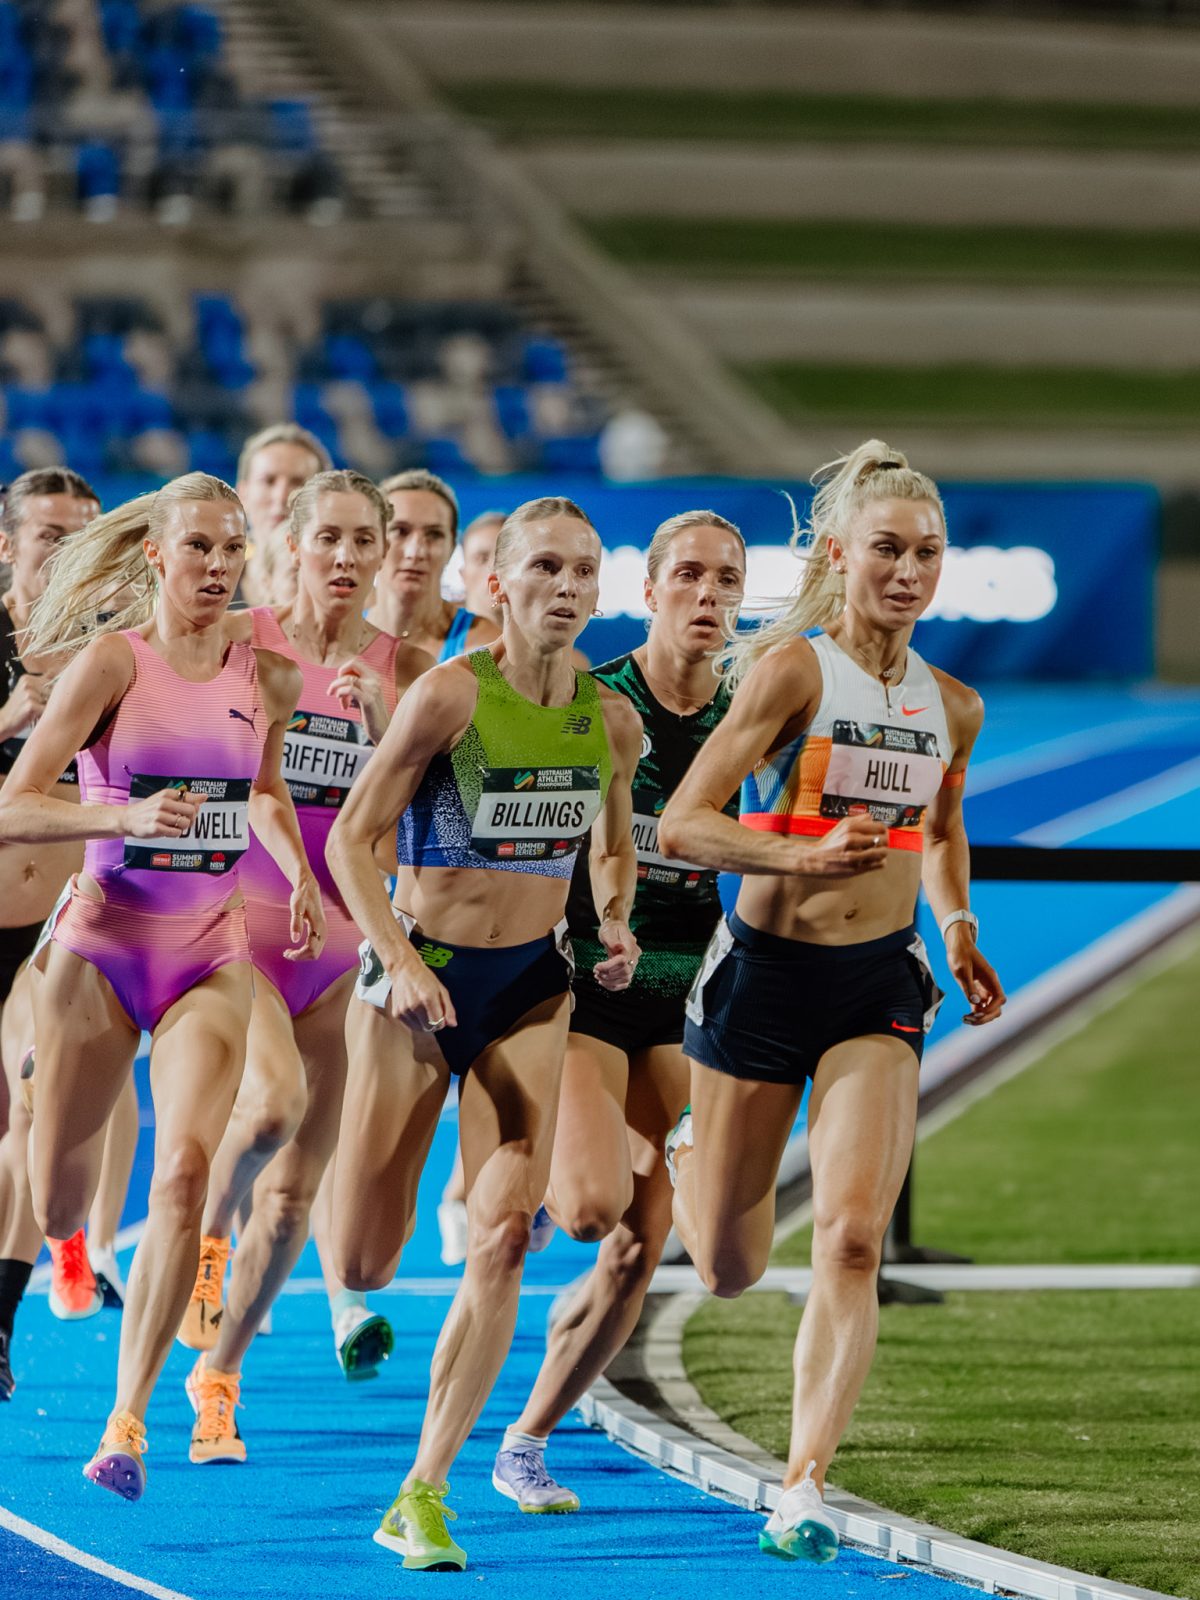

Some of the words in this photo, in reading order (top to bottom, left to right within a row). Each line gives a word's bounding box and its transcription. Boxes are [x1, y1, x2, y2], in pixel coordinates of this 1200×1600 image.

[283, 742, 358, 778] RIFFITH
[864, 760, 911, 793] HULL
[490, 801, 585, 828] BILLINGS
[648, 868, 680, 879] SUMMER
